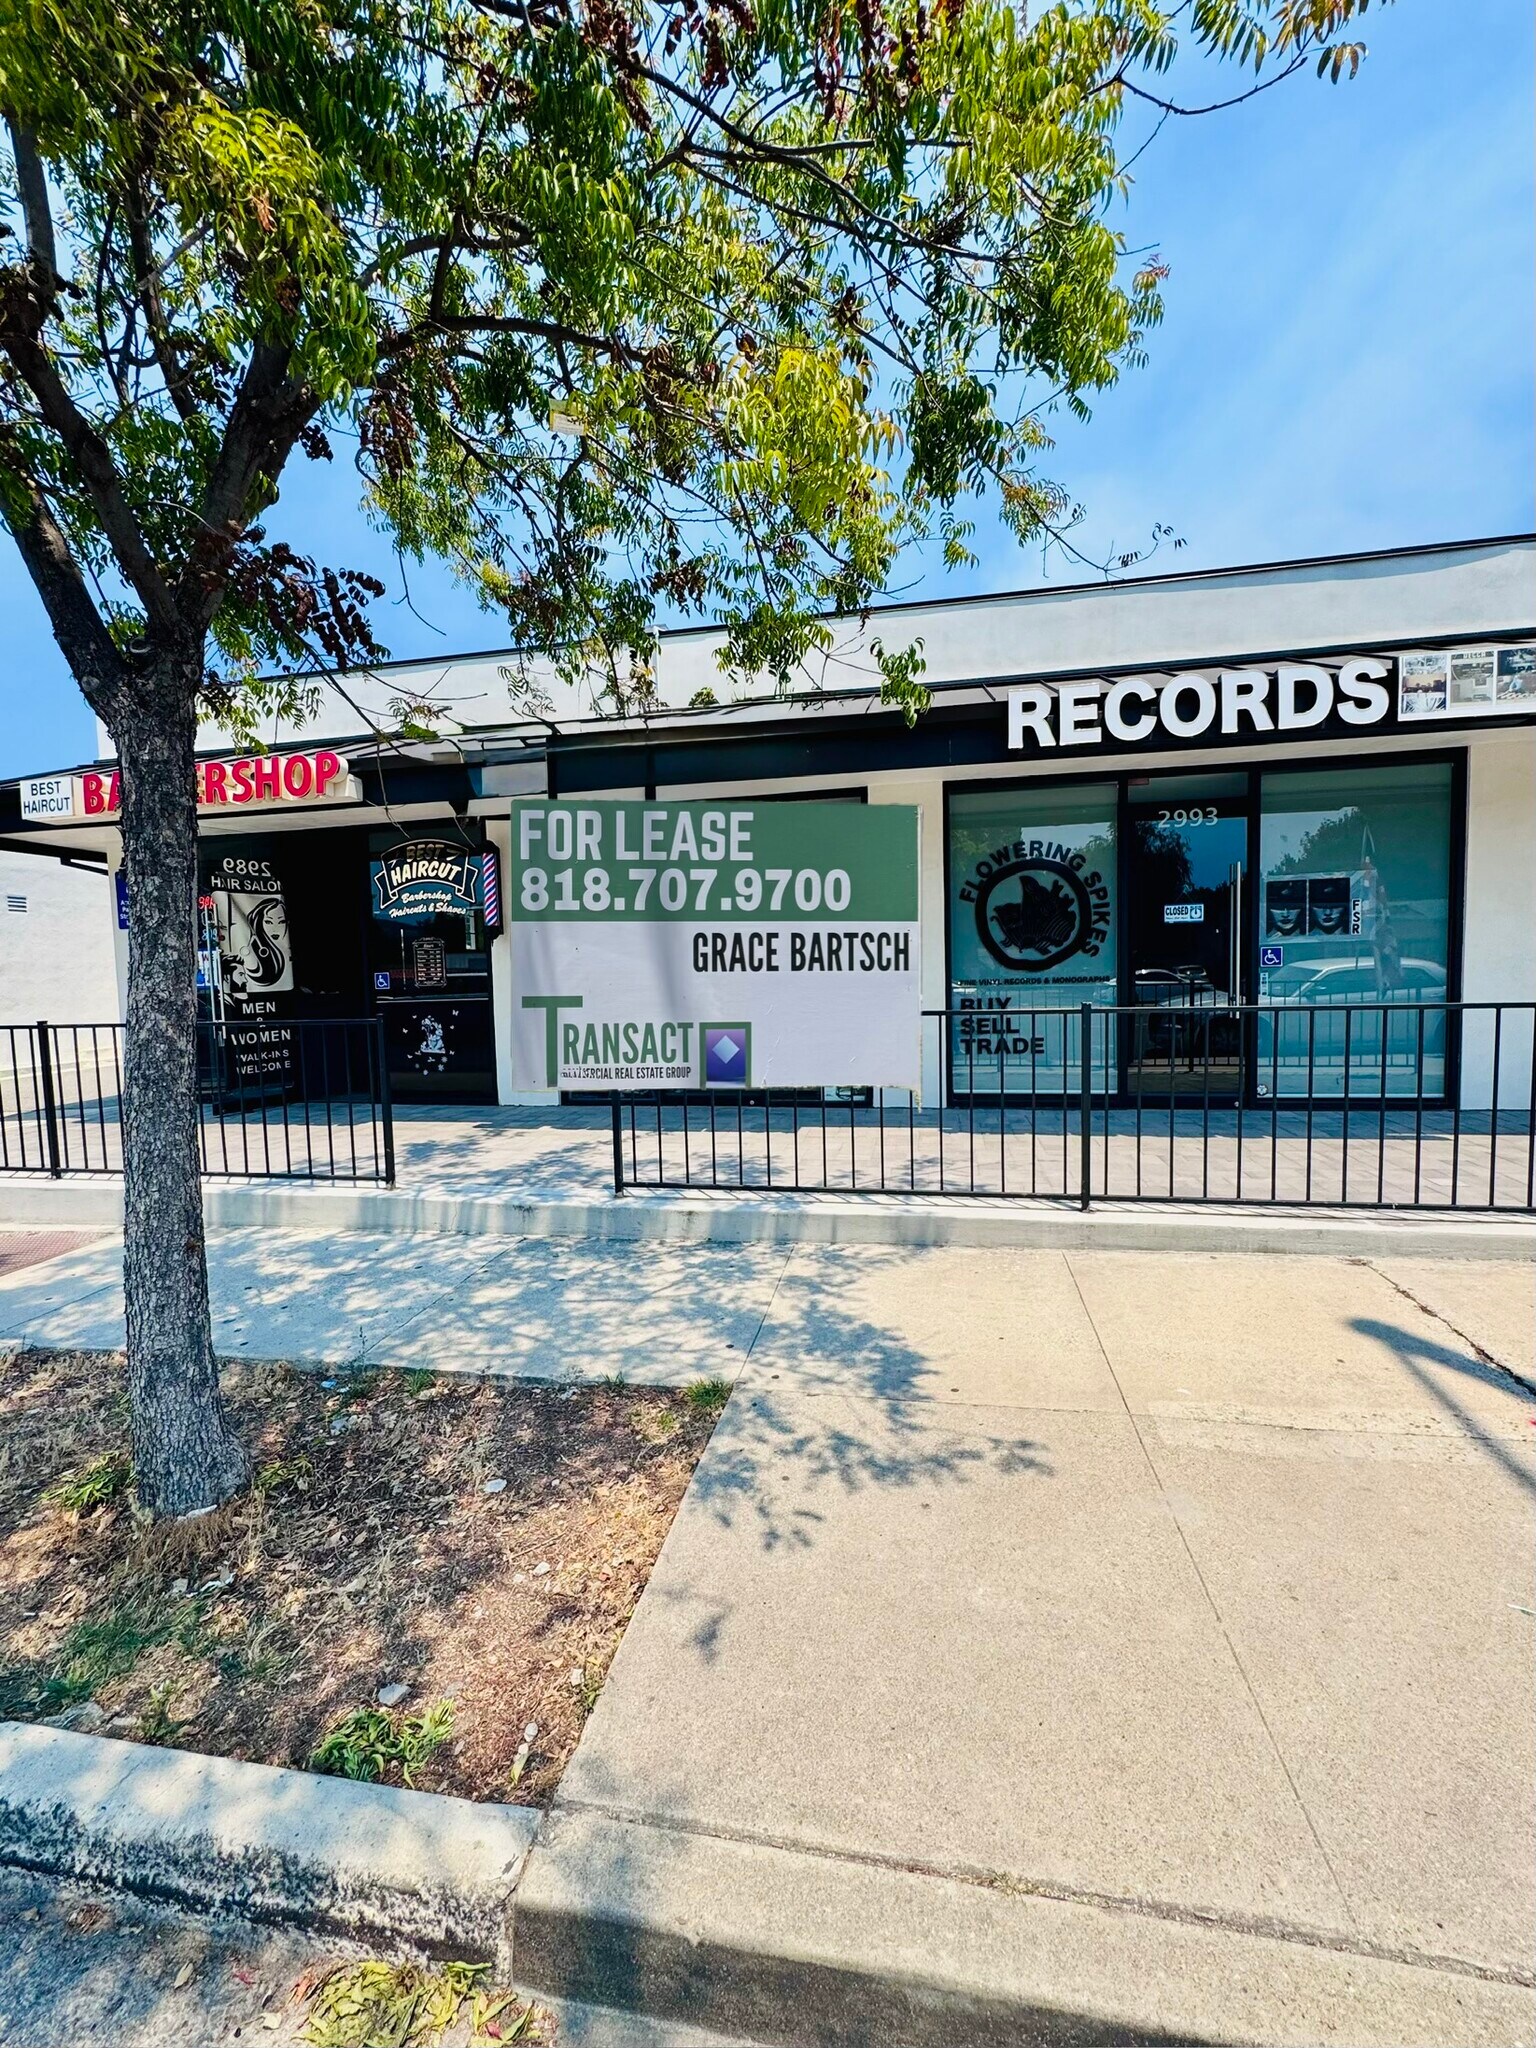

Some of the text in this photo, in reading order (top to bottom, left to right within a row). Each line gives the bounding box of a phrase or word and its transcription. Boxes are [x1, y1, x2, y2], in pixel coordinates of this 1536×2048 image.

[1008, 659, 1392, 749] RECORDS
[31, 781, 62, 797] BEST
[83, 752, 340, 816] BARSHOP
[23, 797, 71, 815] HAIRCUT
[1158, 807, 1218, 828] 2993
[520, 809, 754, 862] FOR LEASE
[406, 843, 444, 862] BEST
[390, 860, 462, 887] HAIRCUT
[211, 876, 241, 890] HAIR
[521, 867, 851, 912] 818.707.9700
[959, 840, 1111, 958] FLOWERING SPIKES
[1166, 906, 1188, 916] CLOSED
[693, 932, 910, 972] GRACE BARTSCH
[1004, 977, 1041, 985] RECORDS
[1052, 975, 1110, 984] MONOGRAPHS
[242, 1002, 276, 1014] MEN
[960, 997, 1012, 1009] BUY
[960, 1017, 1020, 1035] SELL
[231, 1029, 291, 1045] WOMEN
[522, 996, 694, 1087] TRANSACT
[960, 1037, 1045, 1055] TRADE
[236, 1061, 291, 1074] WELCOME
[614, 1067, 634, 1080] REAL
[636, 1066, 664, 1079] ESTATE
[665, 1066, 692, 1079] GROUP
